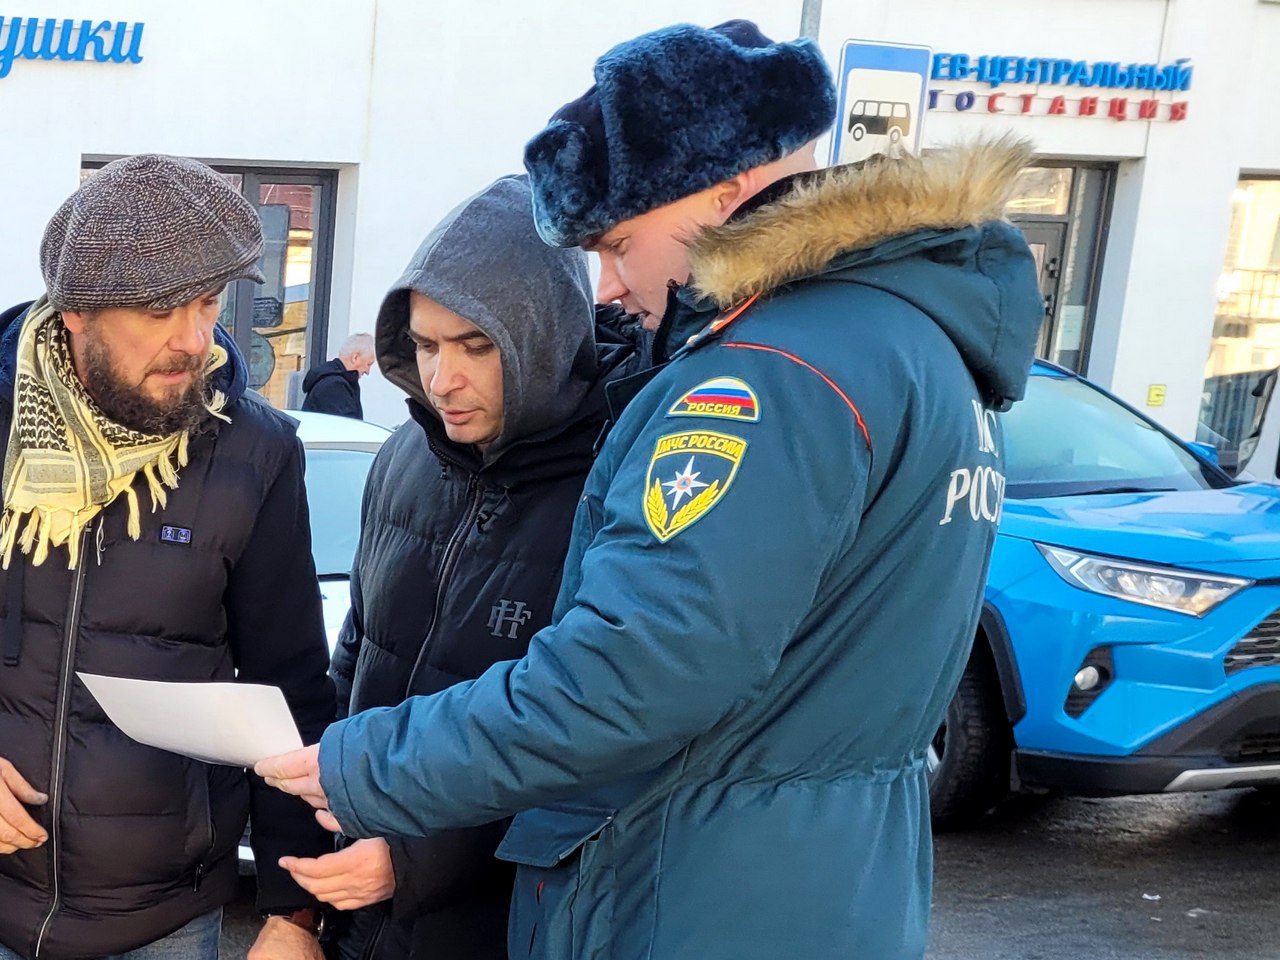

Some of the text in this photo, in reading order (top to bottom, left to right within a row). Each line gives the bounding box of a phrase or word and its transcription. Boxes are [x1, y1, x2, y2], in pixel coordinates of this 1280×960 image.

[687, 402, 742, 415] РОССИЯ
[658, 435, 743, 457] МЧС РОССИИ
